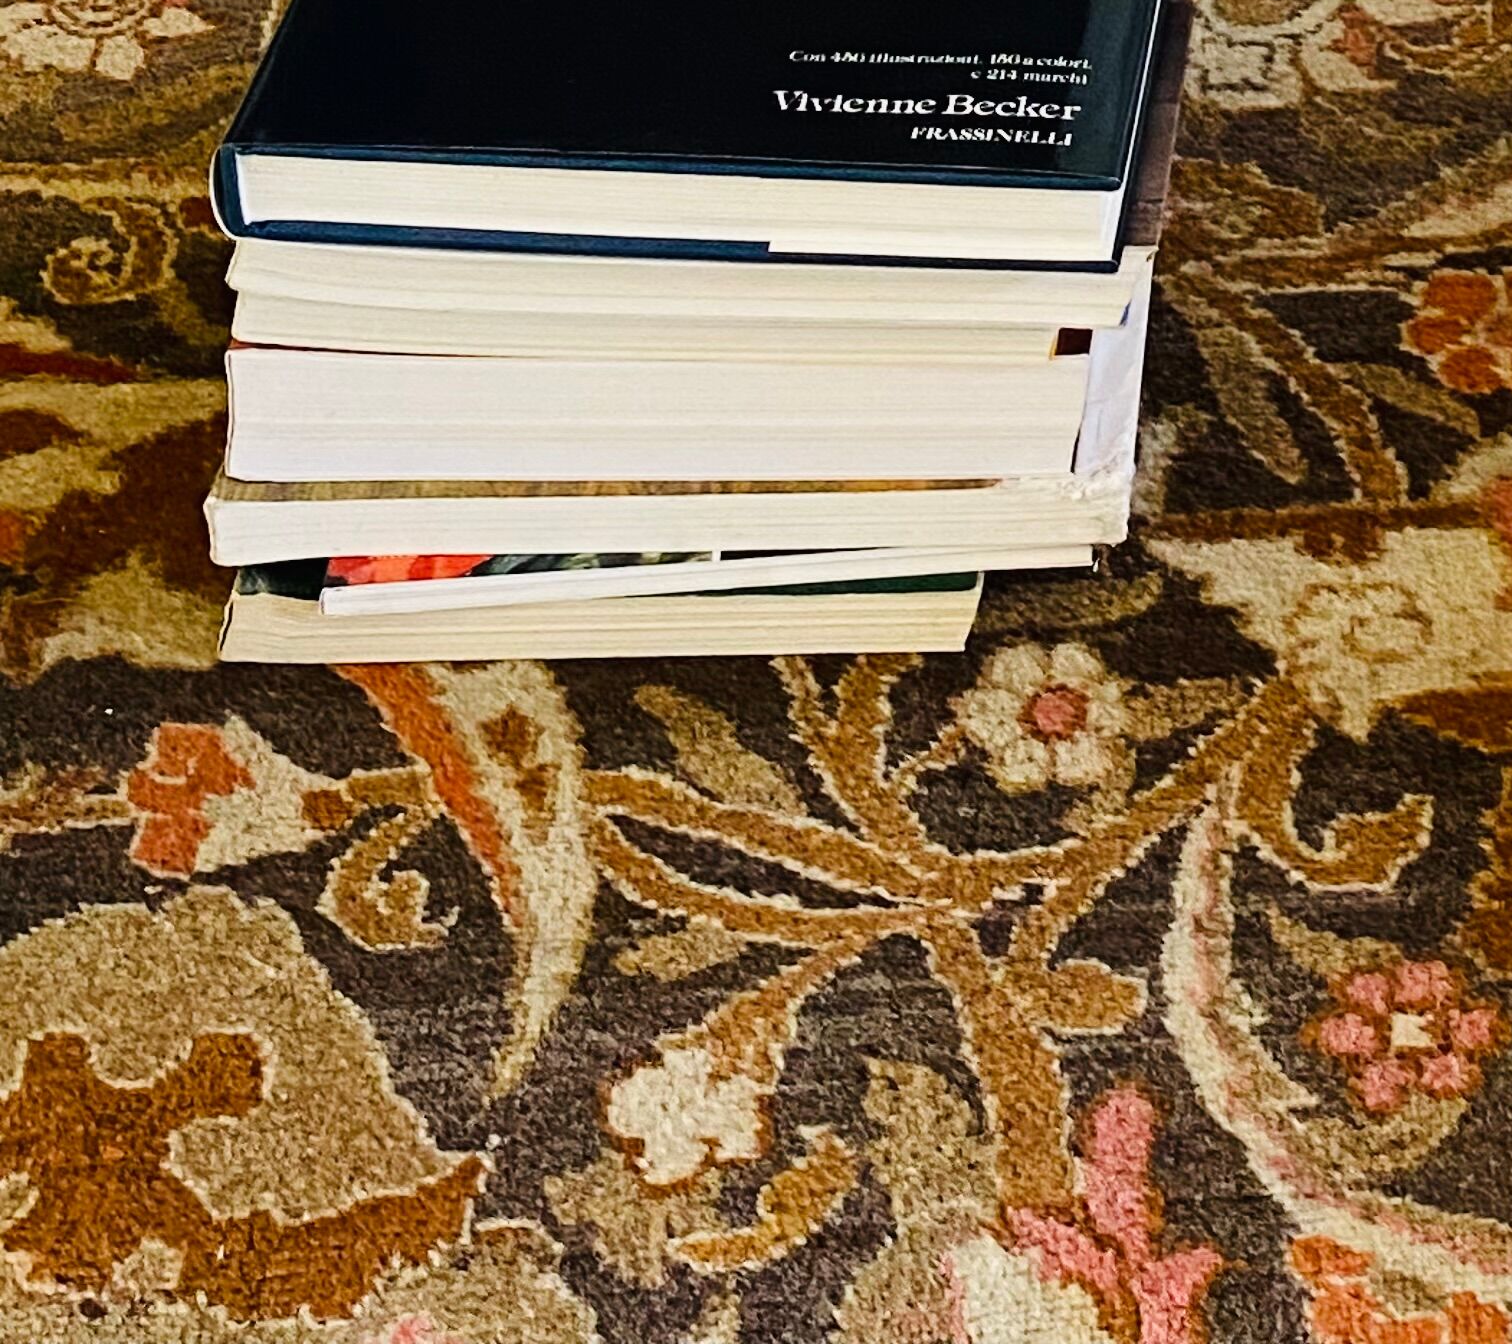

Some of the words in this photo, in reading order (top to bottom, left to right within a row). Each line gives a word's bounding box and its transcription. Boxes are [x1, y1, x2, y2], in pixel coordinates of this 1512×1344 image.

[789, 50, 827, 63] Con
[772, 89, 937, 115] Vivienne
[940, 93, 1082, 121] Becker
[909, 125, 1073, 147] FRASSINELLI
